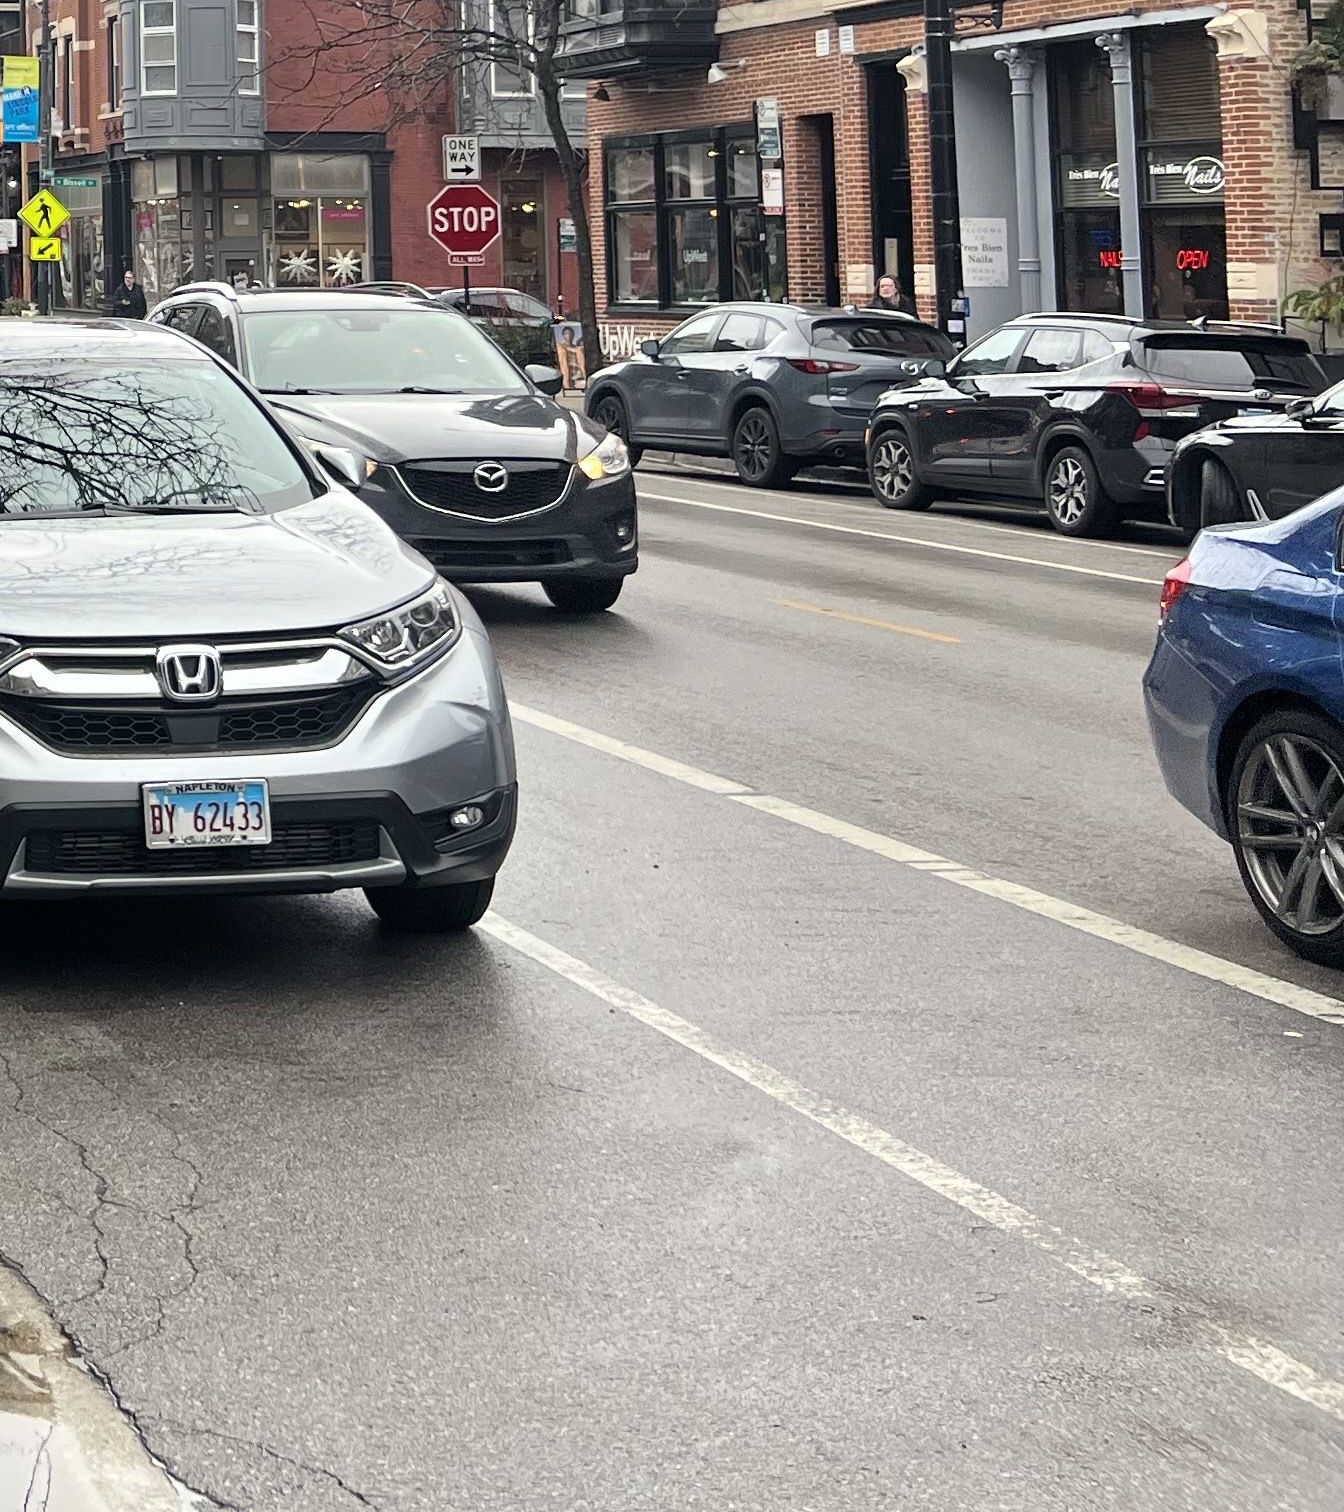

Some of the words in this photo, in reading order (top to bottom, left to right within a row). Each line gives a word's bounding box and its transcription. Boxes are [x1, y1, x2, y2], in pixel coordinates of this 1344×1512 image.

[449, 139, 475, 150] ONE
[448, 151, 476, 163] WAY
[1182, 165, 1222, 186] Nails
[433, 206, 496, 233] STOP
[961, 244, 979, 252] res
[981, 243, 1003, 252] Bien
[968, 254, 993, 263] Nails
[1176, 249, 1210, 269] OPEN
[175, 782, 236, 795] NAPLETON
[150, 803, 176, 835] BY
[193, 800, 264, 833] 62433
